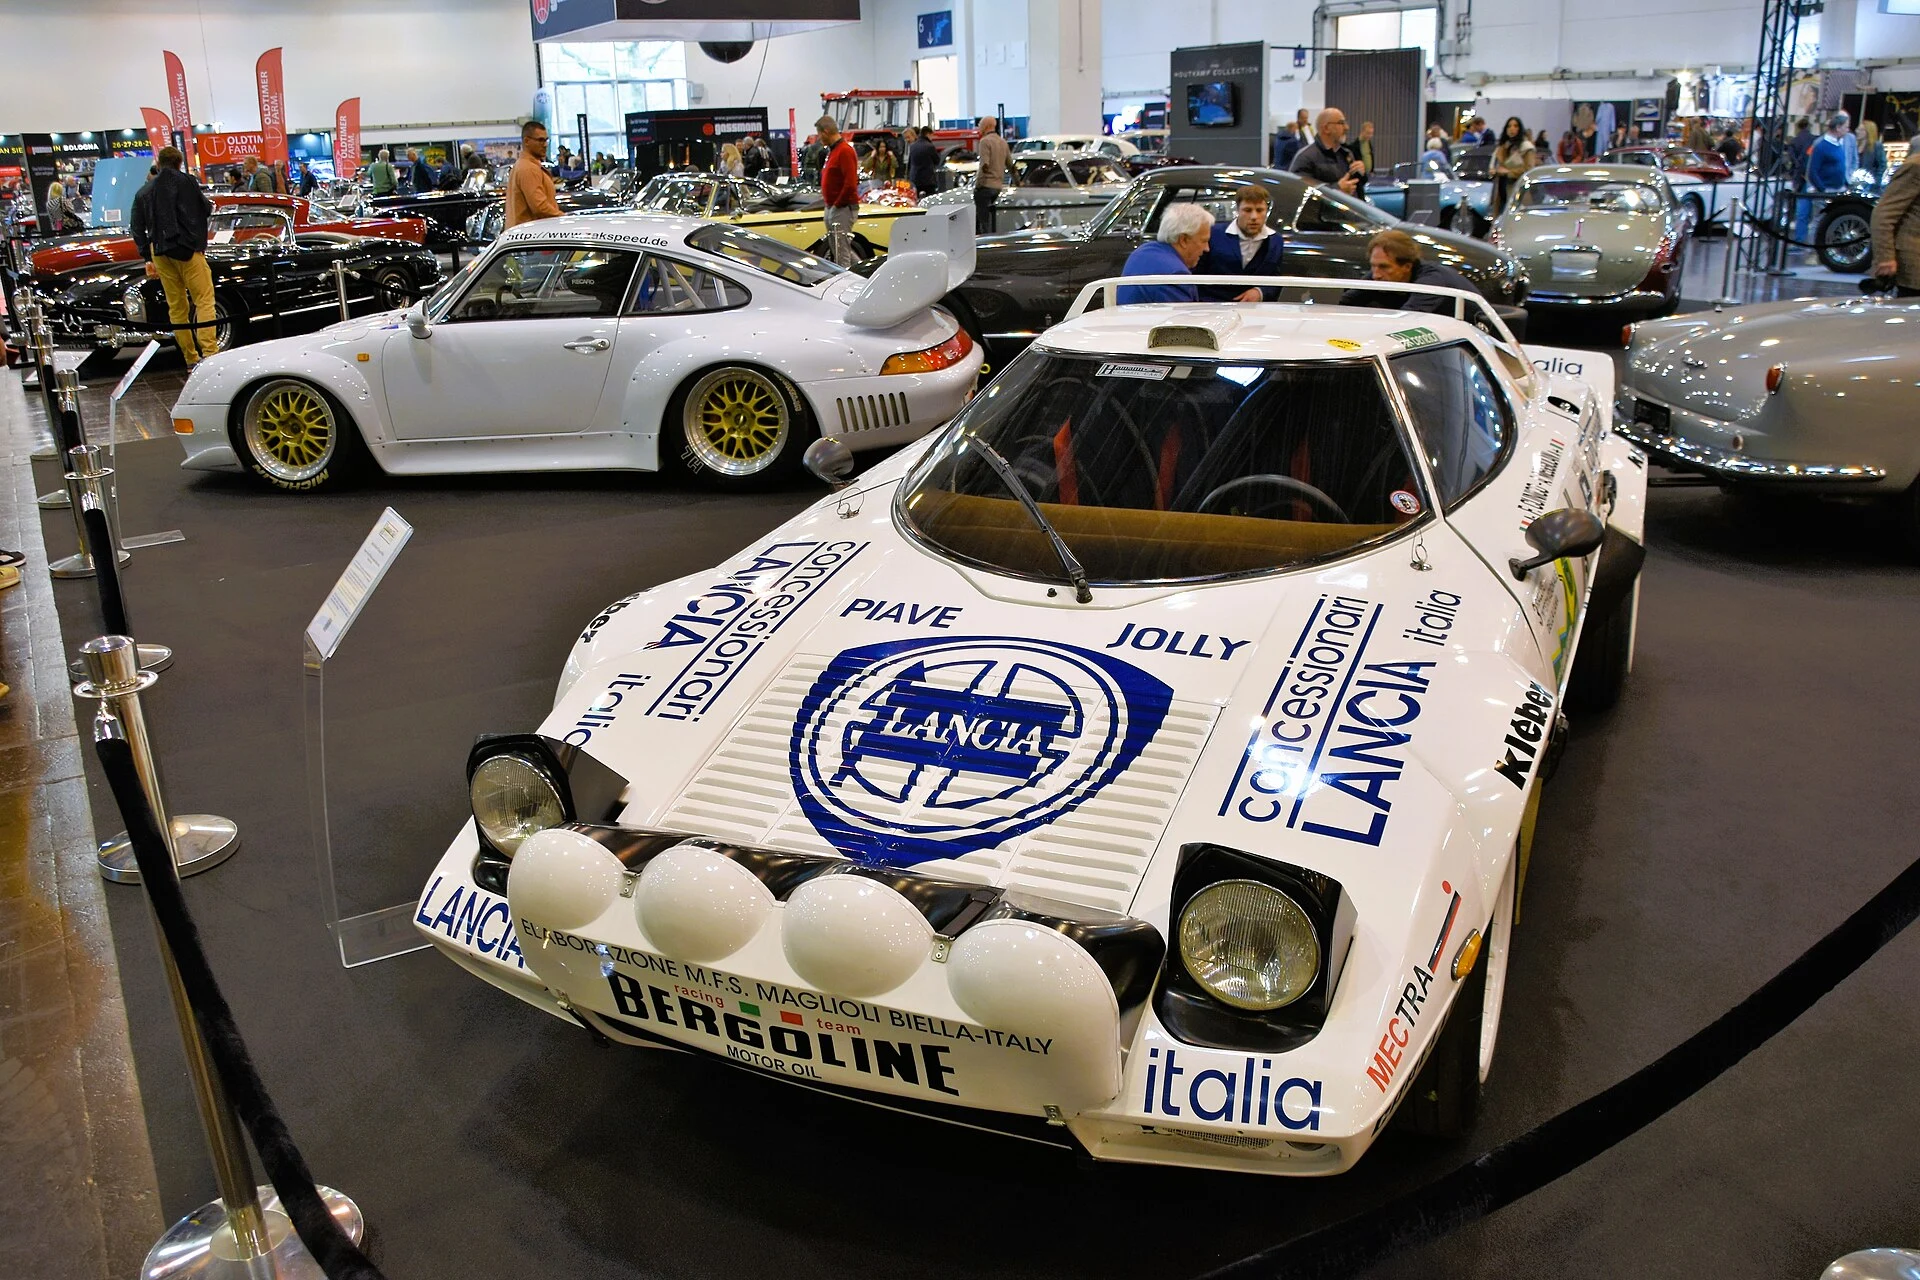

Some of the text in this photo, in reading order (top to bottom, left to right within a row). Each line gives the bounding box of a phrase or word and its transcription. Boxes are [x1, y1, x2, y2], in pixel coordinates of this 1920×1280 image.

[918, 18, 925, 34] 6
[1212, 66, 1259, 76] COLLECTION
[260, 71, 271, 126] OLDTIMER
[271, 92, 279, 125] FARM.
[63, 143, 100, 152] BOLOGNA
[228, 144, 260, 154] FARM.
[506, 231, 669, 247] http://www.zakspeed.de
[1533, 358, 1582, 376] alia
[252, 464, 330, 490] MICHELIN
[643, 541, 820, 650] LANCIA
[839, 598, 964, 628] PIAVE
[658, 541, 856, 722] concessionari
[1403, 590, 1462, 646] italia
[1105, 622, 1252, 660] JOLLY
[1238, 594, 1369, 822] concessionari
[880, 705, 1044, 758] LANCIA
[1301, 662, 1438, 847] LANCIA
[520, 918, 1053, 1054] ELABORAZIONE M.F.S. MAGLIOLI BIELLA-ITALY
[674, 984, 725, 1008] racing
[606, 970, 960, 1097] BERGOLINE
[816, 1018, 862, 1036] team
[1366, 965, 1434, 1094] MECTRA
[726, 1044, 822, 1080] MOTOR OIL
[1144, 1048, 1322, 1131] italia
